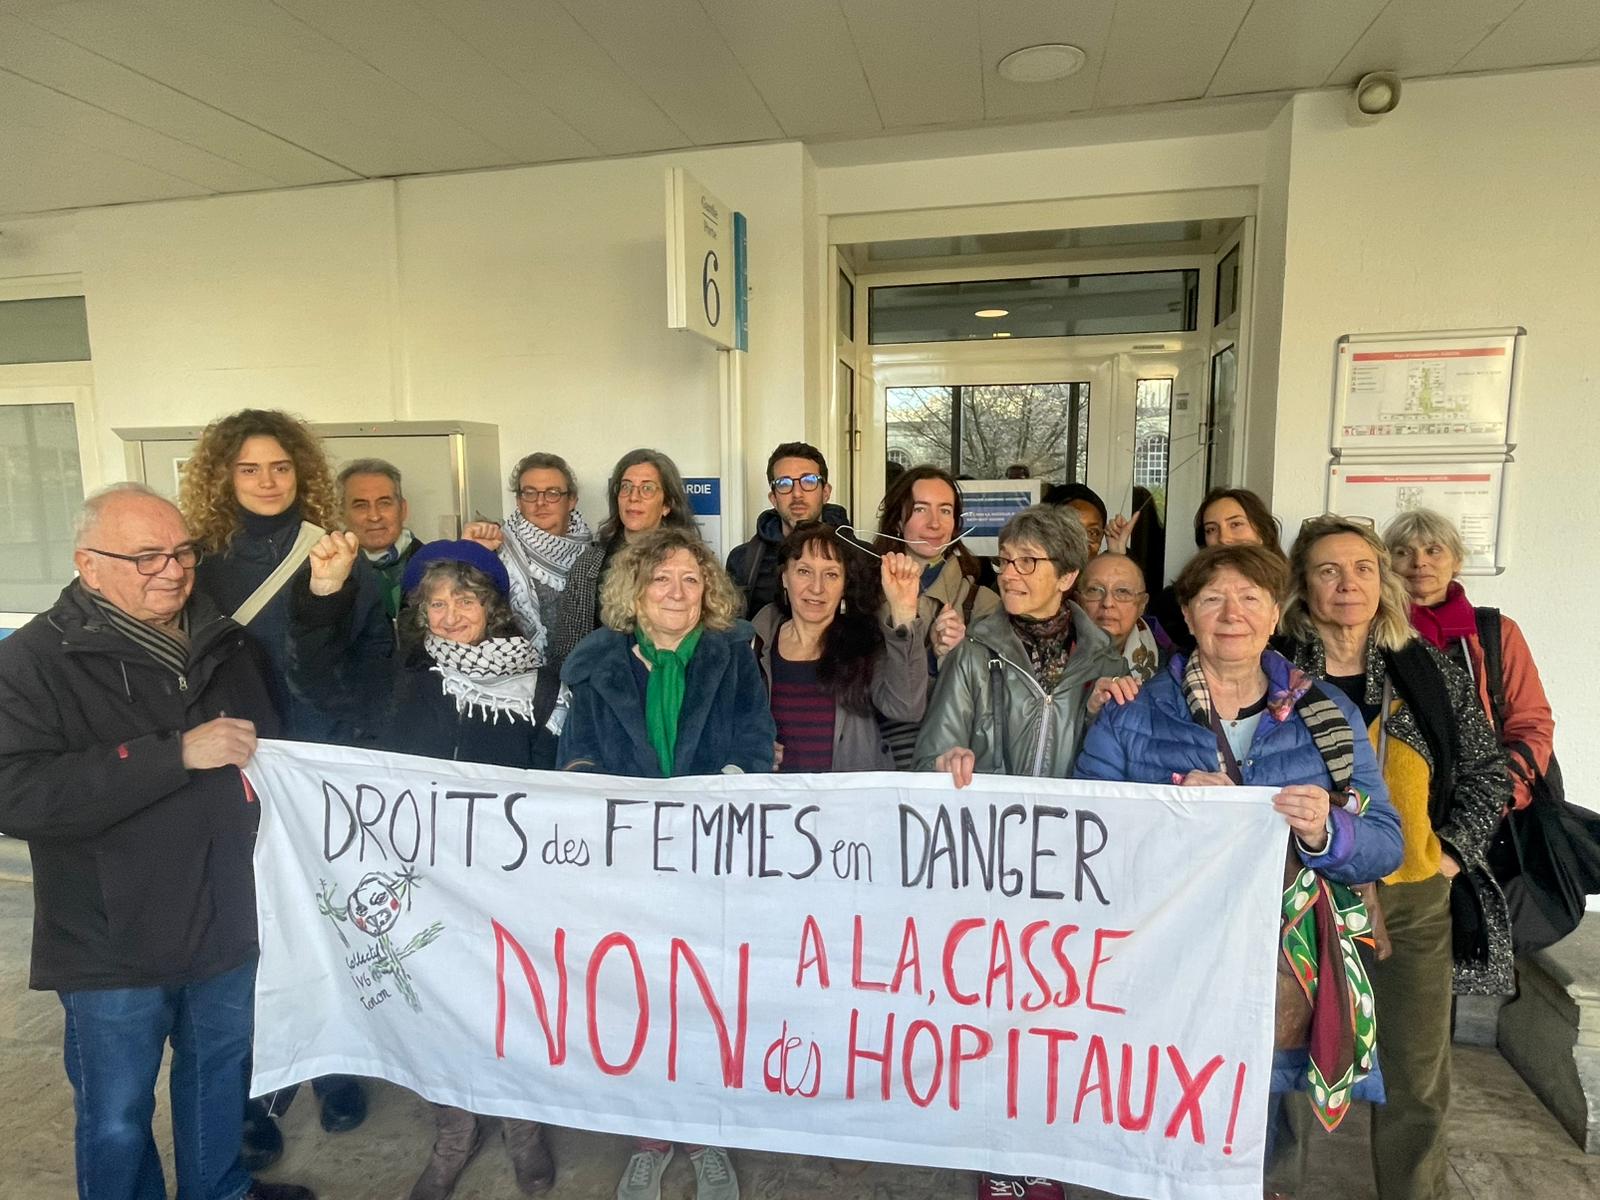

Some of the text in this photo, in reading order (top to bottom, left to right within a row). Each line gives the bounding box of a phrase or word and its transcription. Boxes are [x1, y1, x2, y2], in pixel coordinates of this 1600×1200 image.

[703, 250, 721, 328] 6
[541, 824, 591, 867] des
[605, 798, 823, 880] FEMMES
[829, 838, 872, 882] en
[899, 803, 1111, 905] DANGER
[491, 917, 749, 1089] NON
[796, 914, 831, 990] A
[942, 917, 1136, 1016] CASSE
[762, 1008, 1248, 1156] des HOPITAUX!
